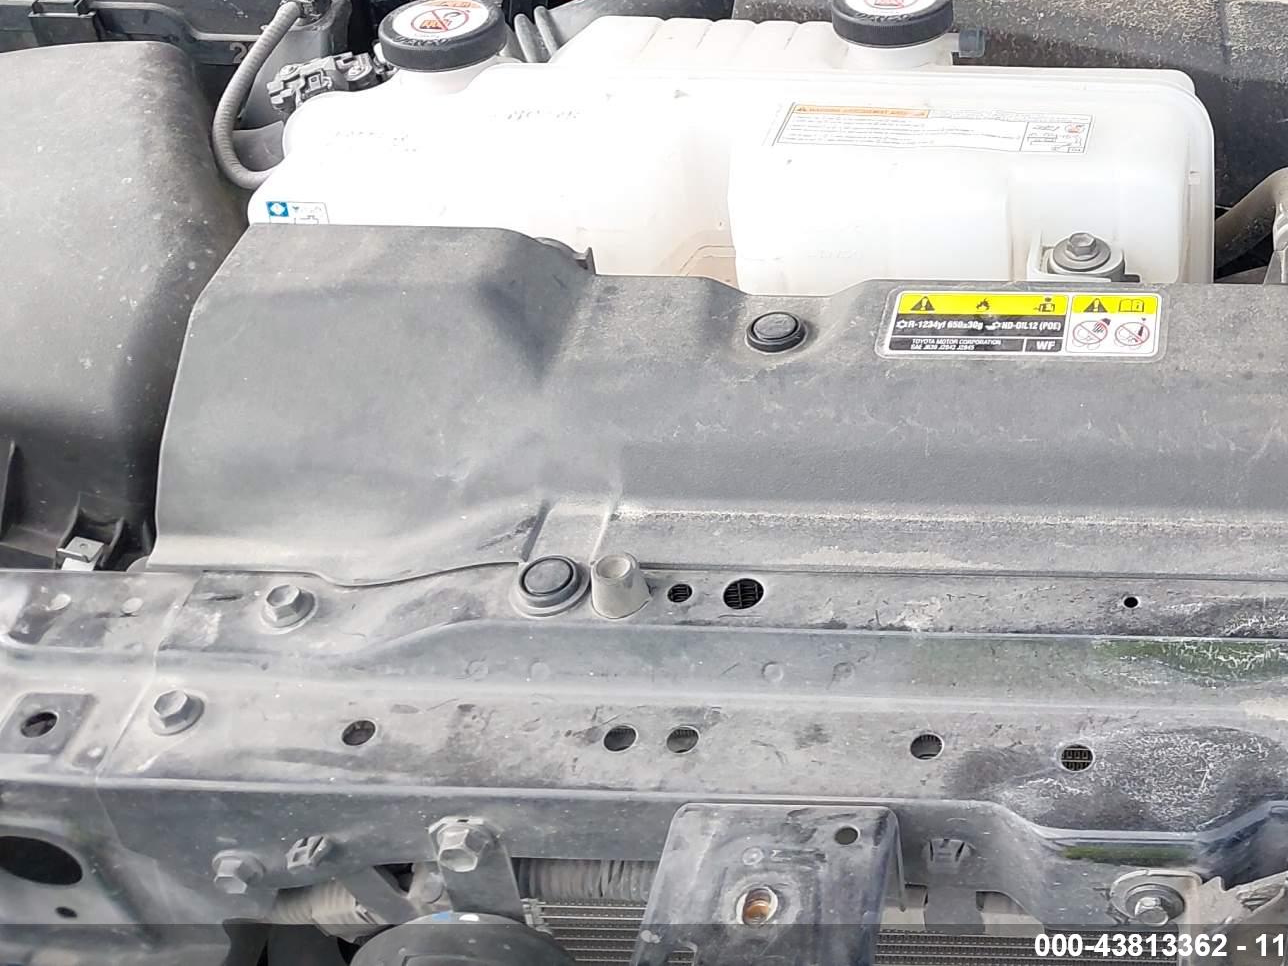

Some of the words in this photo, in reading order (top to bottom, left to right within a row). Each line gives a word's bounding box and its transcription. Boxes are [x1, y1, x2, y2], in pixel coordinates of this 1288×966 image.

[907, 320, 946, 330] R-1234yf
[1001, 321, 1038, 330] ND-OIL12
[1039, 321, 1062, 331] (POE)
[1036, 340, 1056, 350] WF
